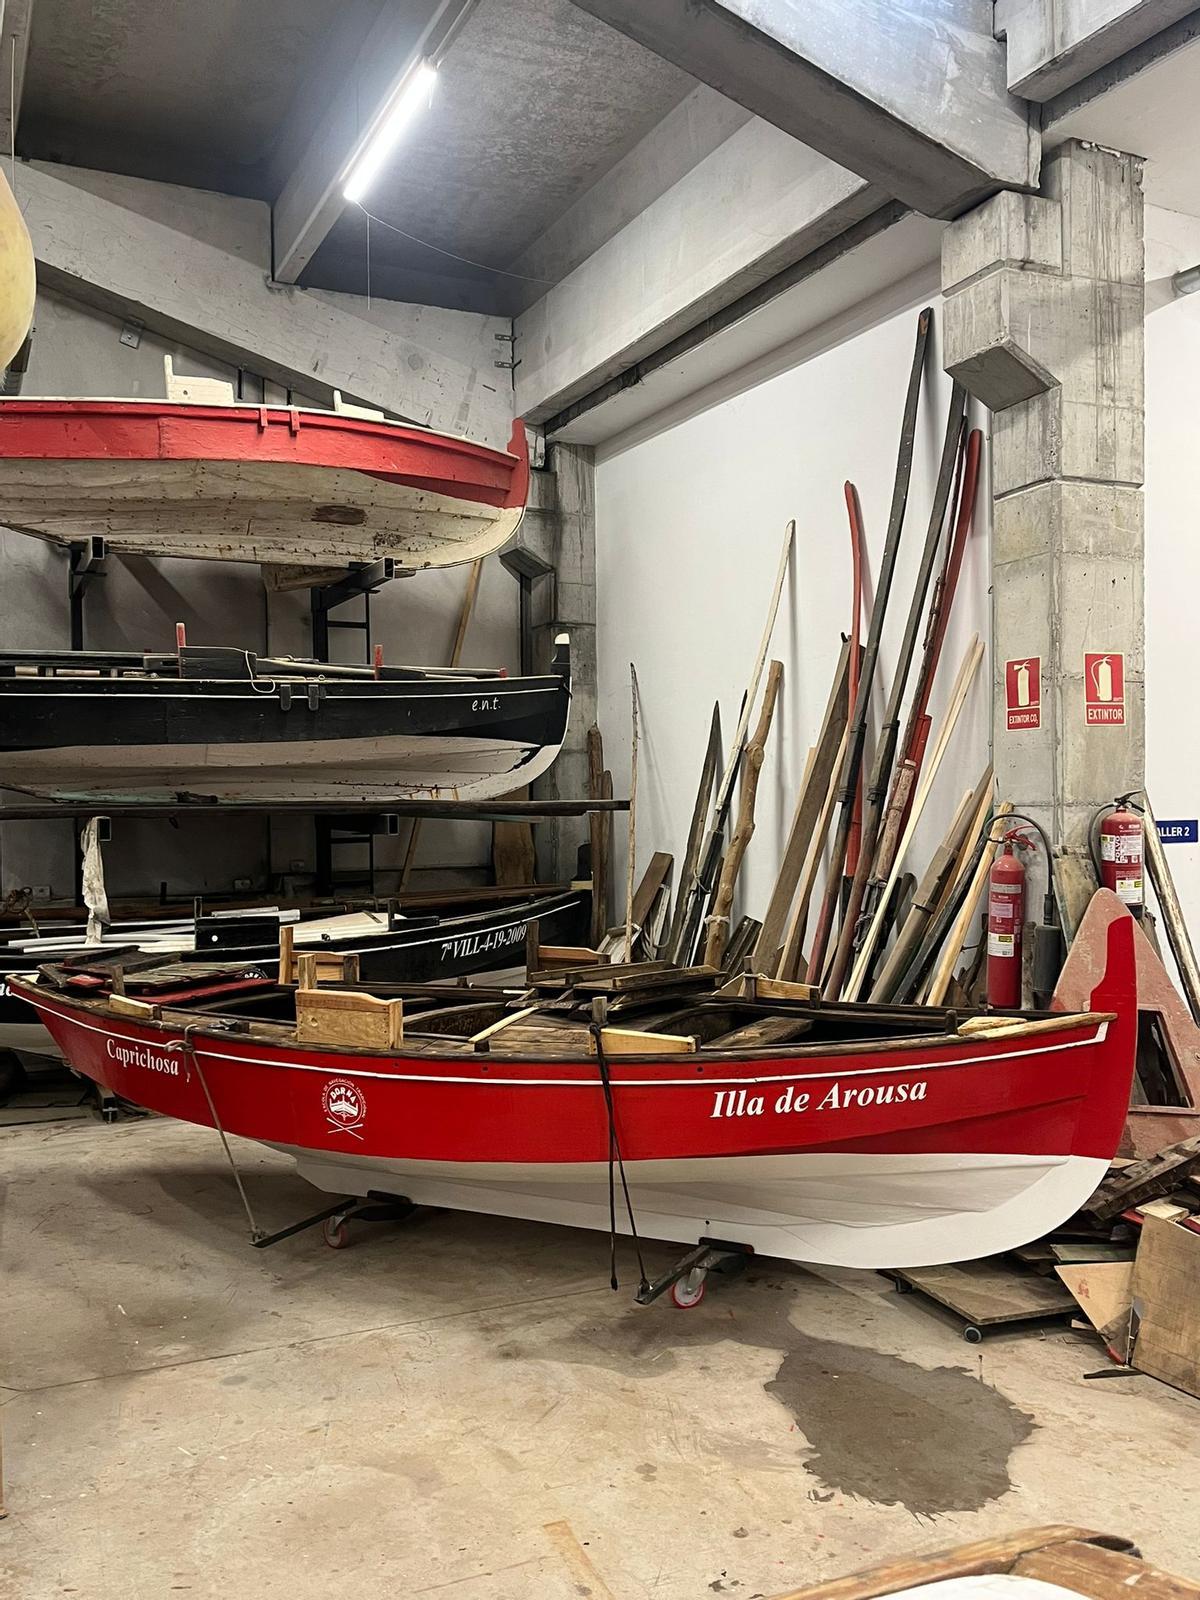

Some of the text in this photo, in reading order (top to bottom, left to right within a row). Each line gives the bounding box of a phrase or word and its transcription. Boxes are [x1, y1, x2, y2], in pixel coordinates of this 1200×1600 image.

[471, 696, 501, 711] e.n.t.
[1088, 708, 1123, 720] EXTINTOR
[1183, 826, 1190, 837] 2
[106, 1038, 179, 1076] Caprichosa
[330, 1086, 357, 1104] DORNA
[709, 1081, 928, 1118] Illa de Arousa
